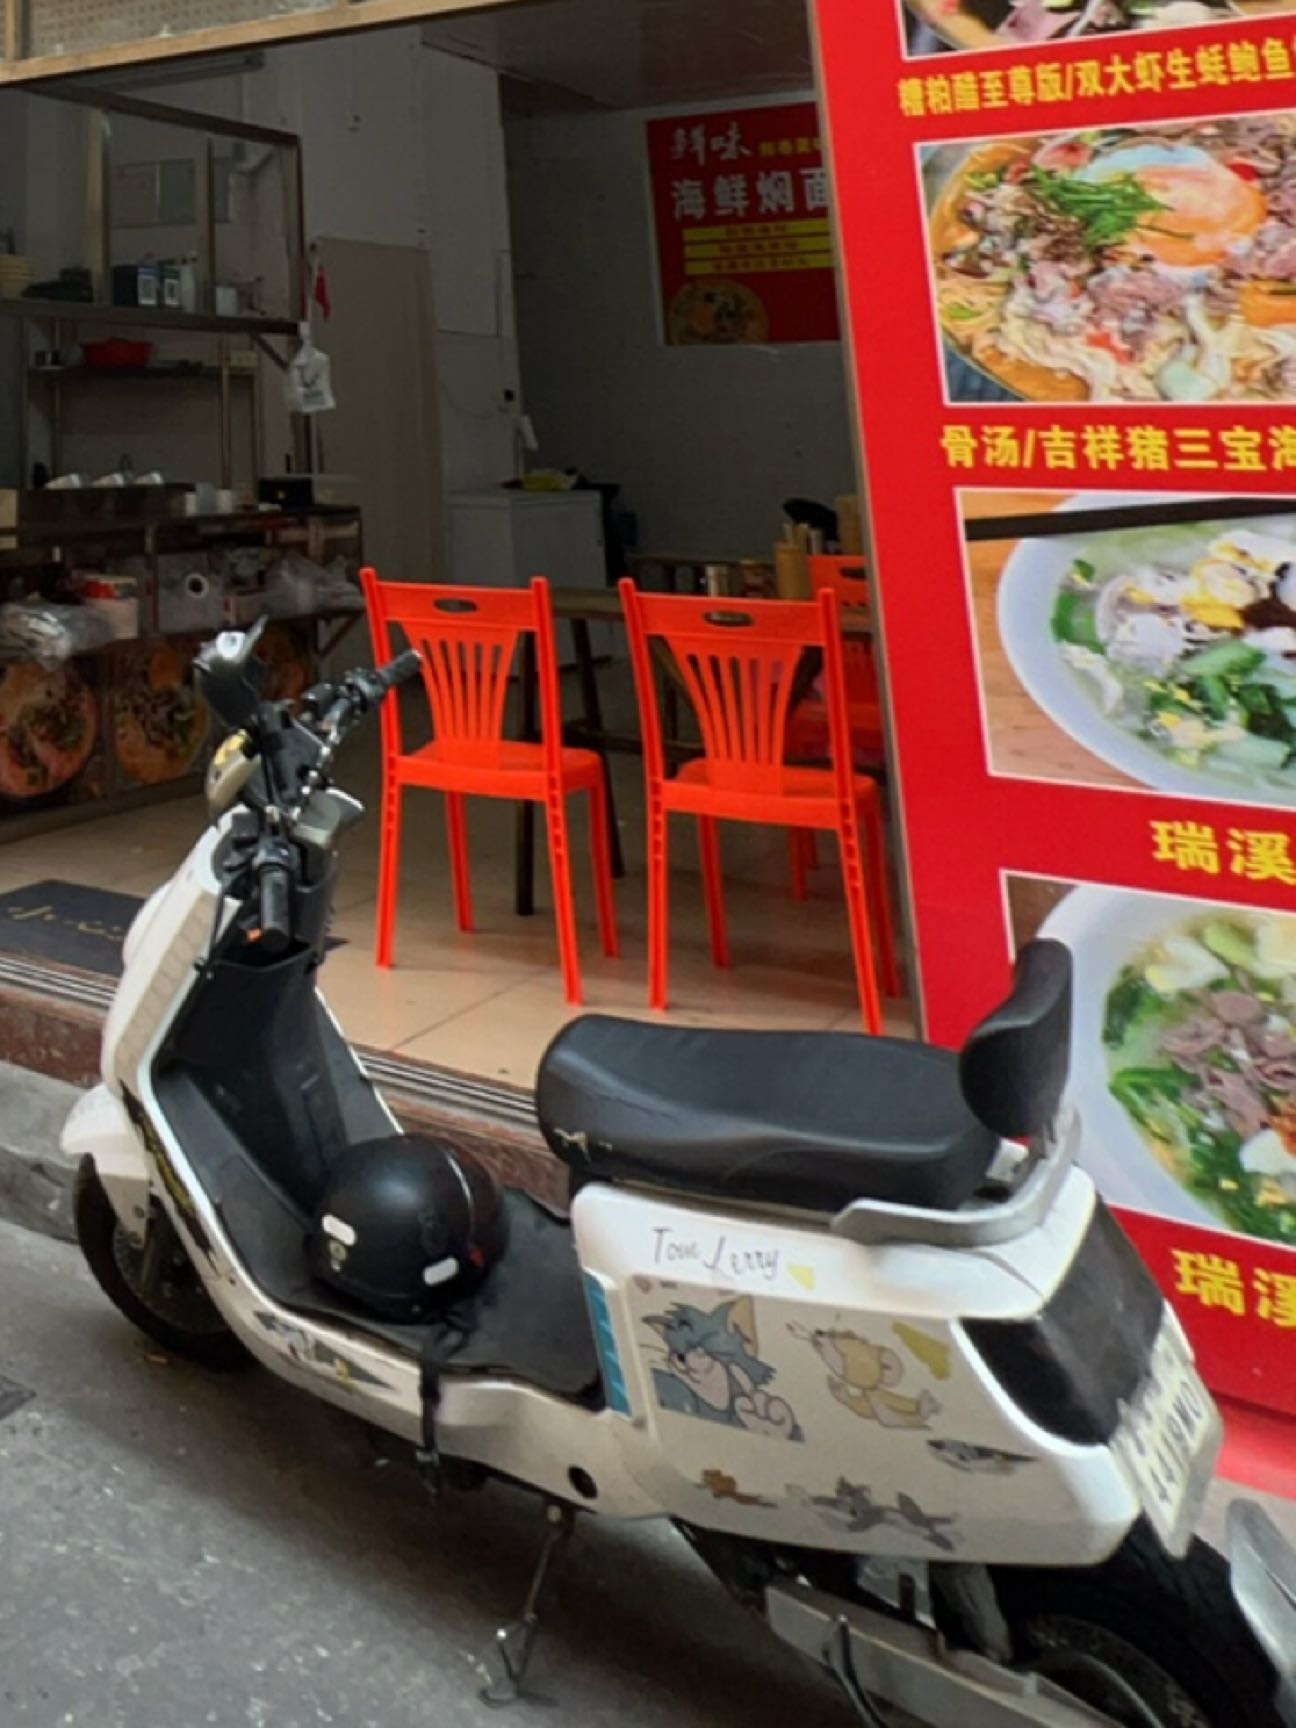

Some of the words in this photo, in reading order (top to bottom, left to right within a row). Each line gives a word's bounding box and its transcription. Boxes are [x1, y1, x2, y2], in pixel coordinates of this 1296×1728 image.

[897, 35, 1296, 117] 糟粕醋至尊版/双大虾生蚝鲍鱼
[670, 166, 830, 221] 海鲜焖面
[1149, 820, 1296, 886] 瑞溪
[1169, 1248, 1296, 1328] 瑞溪
